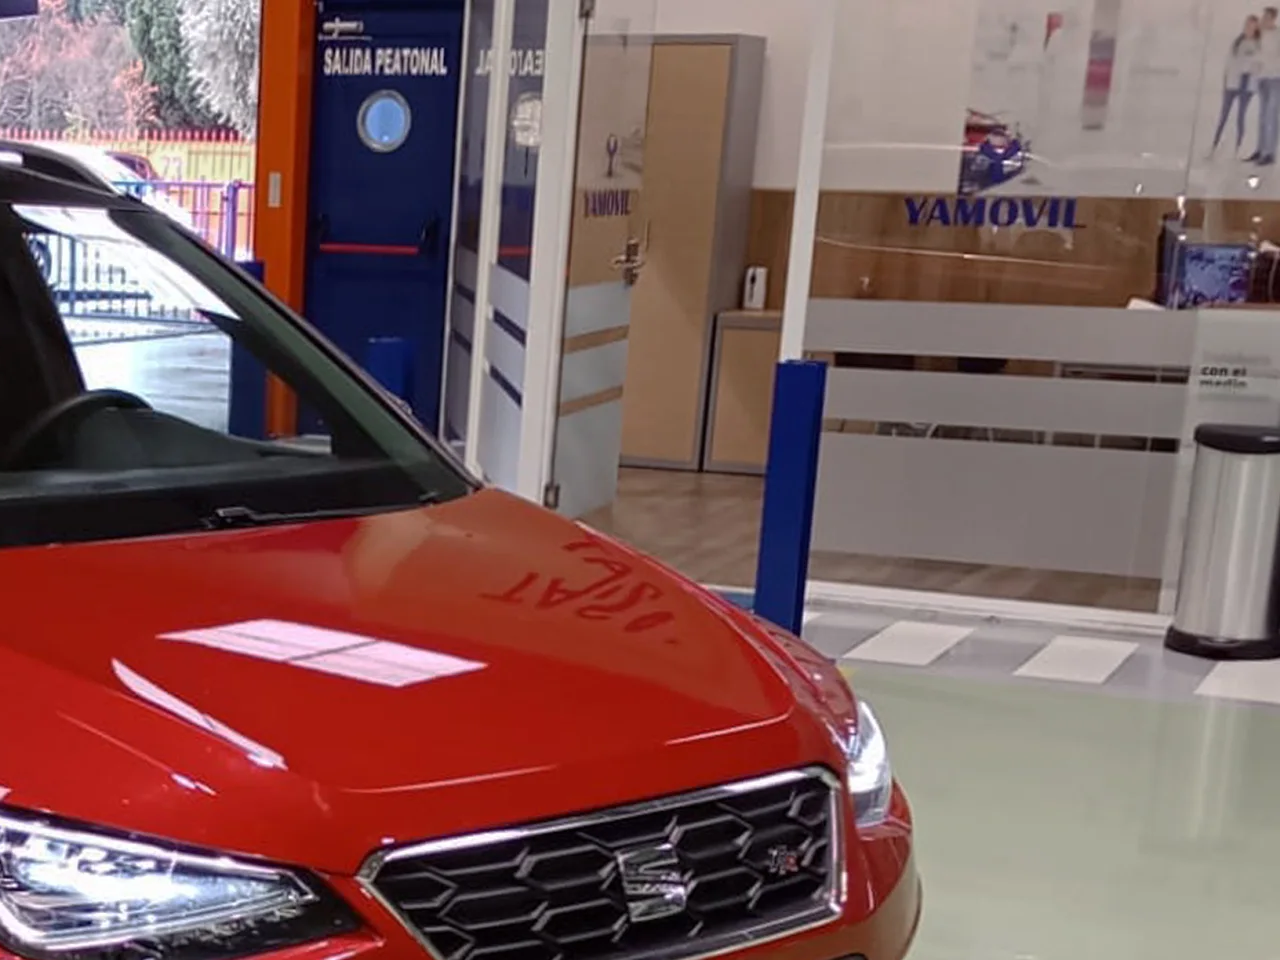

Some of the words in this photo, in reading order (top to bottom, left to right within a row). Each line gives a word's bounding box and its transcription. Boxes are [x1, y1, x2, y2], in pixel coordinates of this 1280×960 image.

[323, 47, 372, 75] SALIDA
[375, 47, 447, 75] PEATONAL
[904, 197, 1087, 228] YAMOVIL
